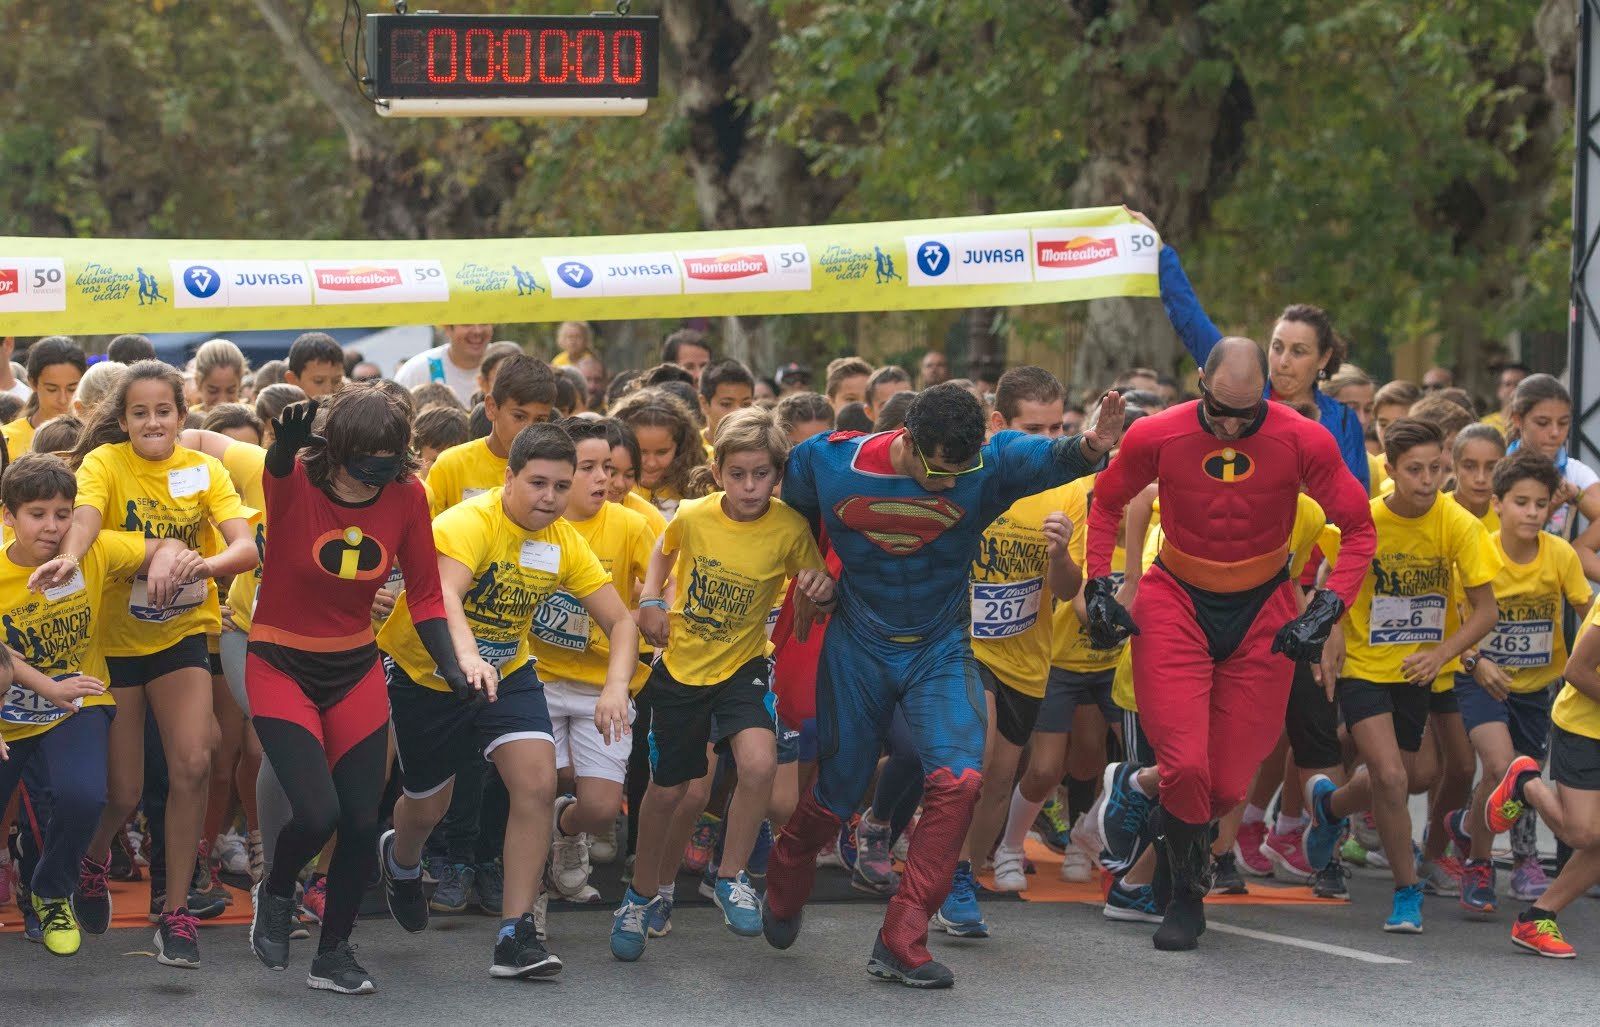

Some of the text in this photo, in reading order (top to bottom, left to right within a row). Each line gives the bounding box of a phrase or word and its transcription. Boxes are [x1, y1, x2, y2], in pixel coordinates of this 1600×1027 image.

[427, 28, 642, 83] 00:00:00
[1131, 234, 1154, 252] 50
[780, 252, 806, 268] 50
[963, 249, 1025, 264] JUVASA
[1042, 246, 1113, 262] Montealbor
[415, 268, 440, 281] 50
[607, 264, 673, 278] JUVASA
[690, 260, 763, 273] Montealbor
[33, 268, 61, 288] 50
[235, 273, 303, 286] JUVASA
[322, 272, 396, 285] Montealbor
[984, 597, 1026, 621] 267
[1490, 634, 1531, 652] 463
